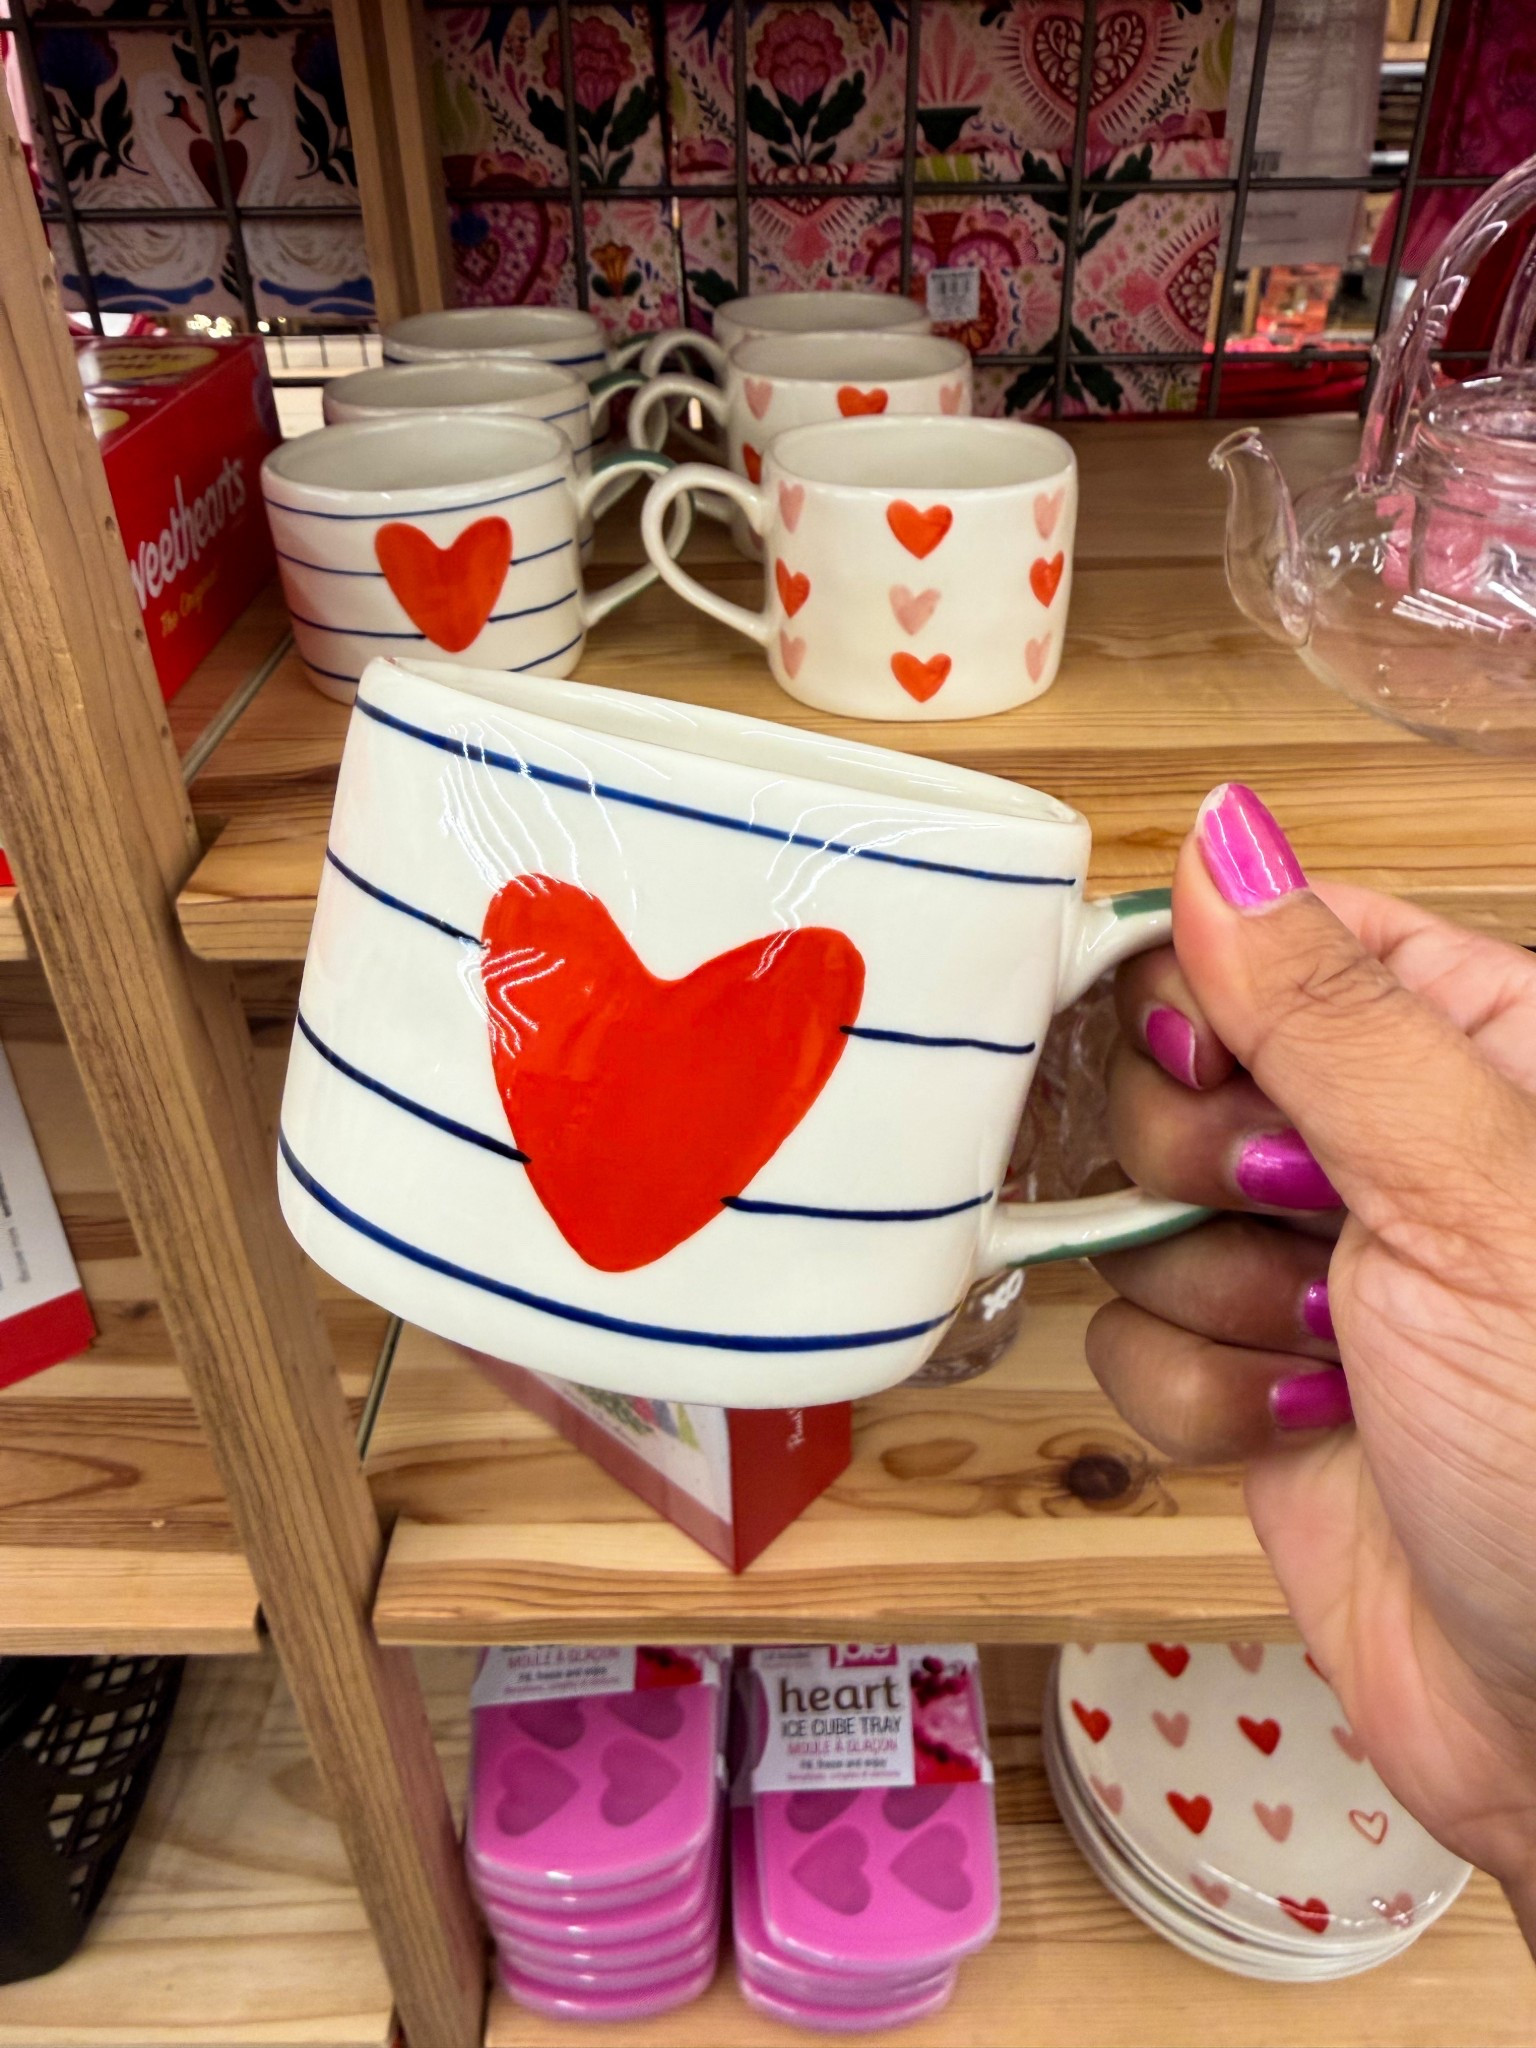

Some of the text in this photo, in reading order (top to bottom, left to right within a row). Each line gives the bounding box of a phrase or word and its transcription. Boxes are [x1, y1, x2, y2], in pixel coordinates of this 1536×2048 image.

[779, 1675, 901, 1713] heart
[783, 1715, 901, 1737] ICE CUBE TRAY
